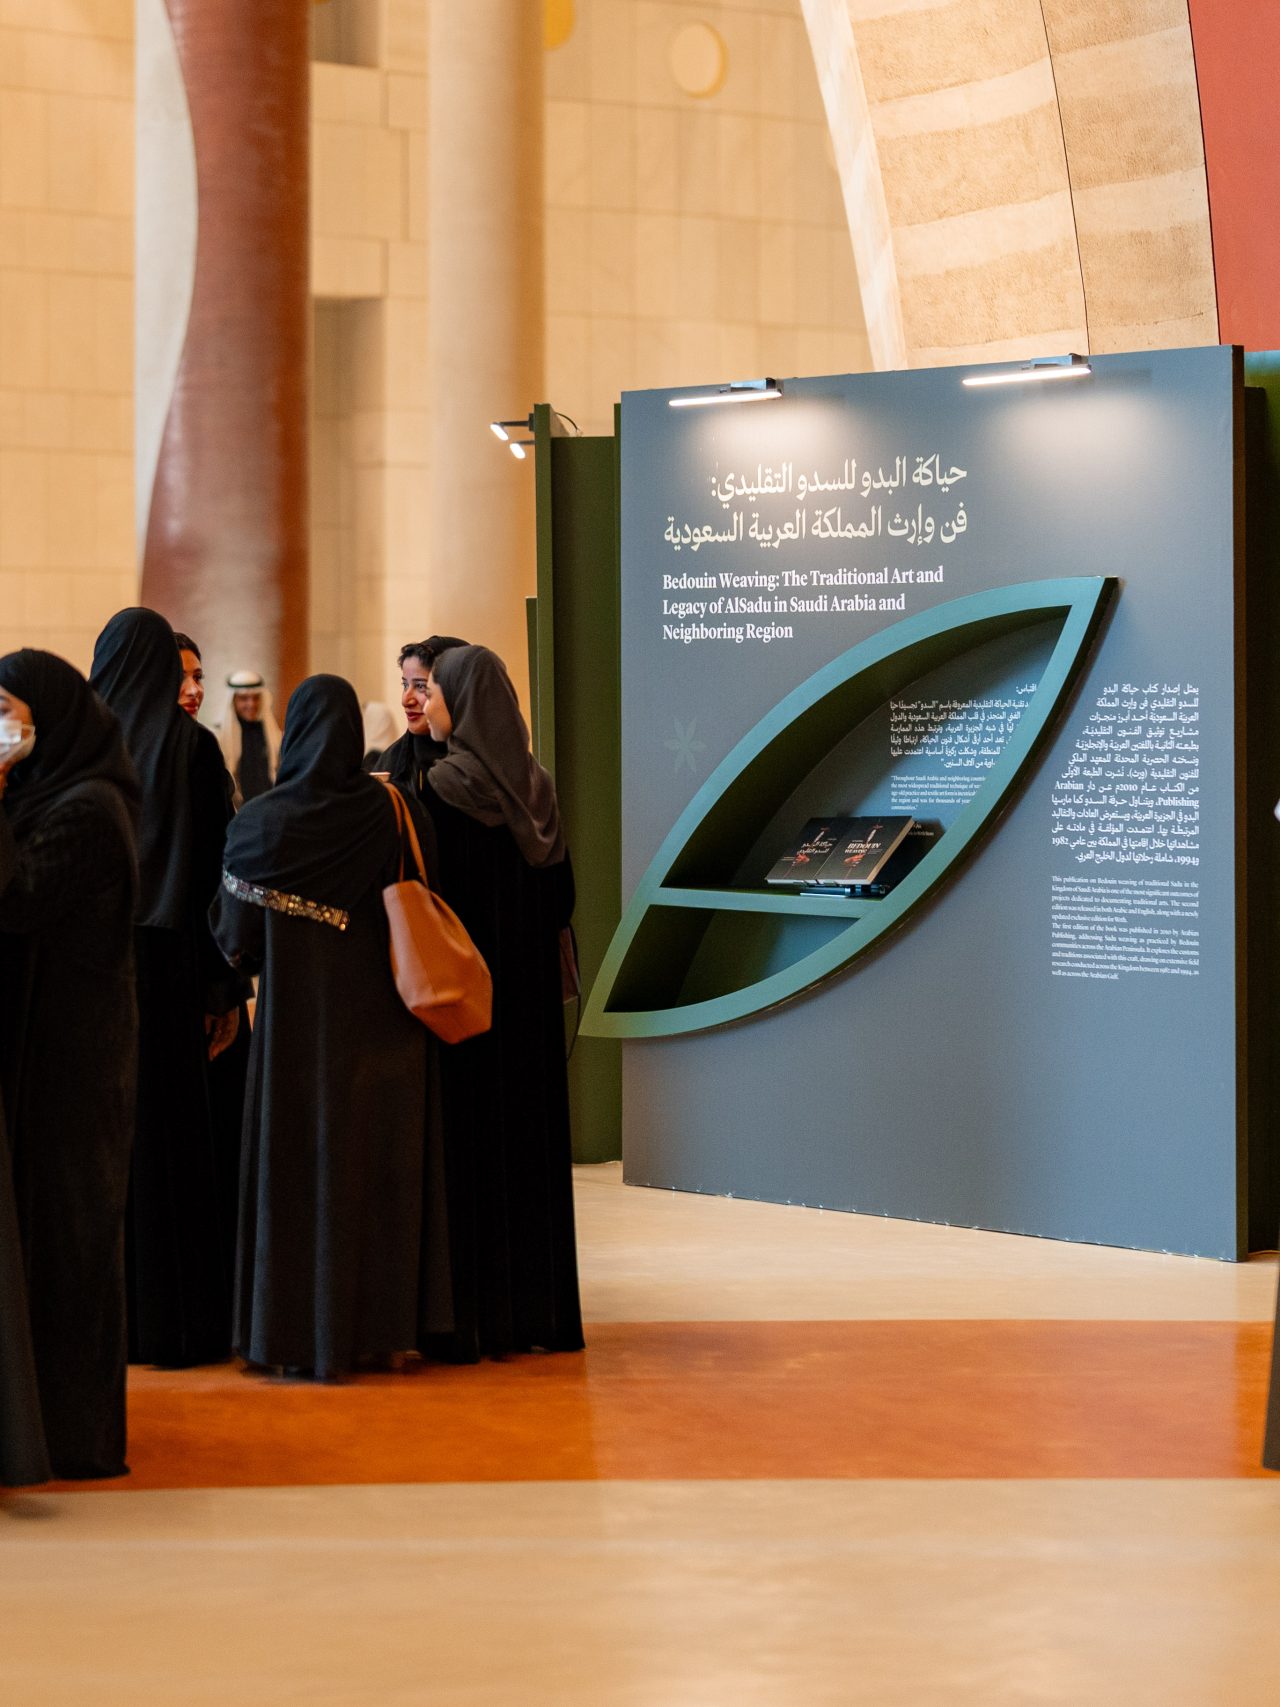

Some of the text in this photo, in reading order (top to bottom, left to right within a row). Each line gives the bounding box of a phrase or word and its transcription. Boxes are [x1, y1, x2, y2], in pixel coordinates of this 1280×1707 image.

[710, 454, 967, 509] حياكة البدو للسدو التقليدي:
[664, 502, 967, 551] فن وإرث المملكة العربية السعودية
[663, 565, 944, 591] Bedouin Weaving: The Traditional Art and
[663, 593, 905, 619] Legacy of AlSadu in Saudi Arabia and
[663, 622, 793, 644] Neighboring Region
[1104, 684, 1118, 695] البدو
[1142, 684, 1159, 695] كتاب
[1096, 697, 1119, 707] المملكة
[1055, 781, 1084, 790] Arabian
[1188, 787, 1199, 795] من
[1052, 836, 1069, 846] 1982
